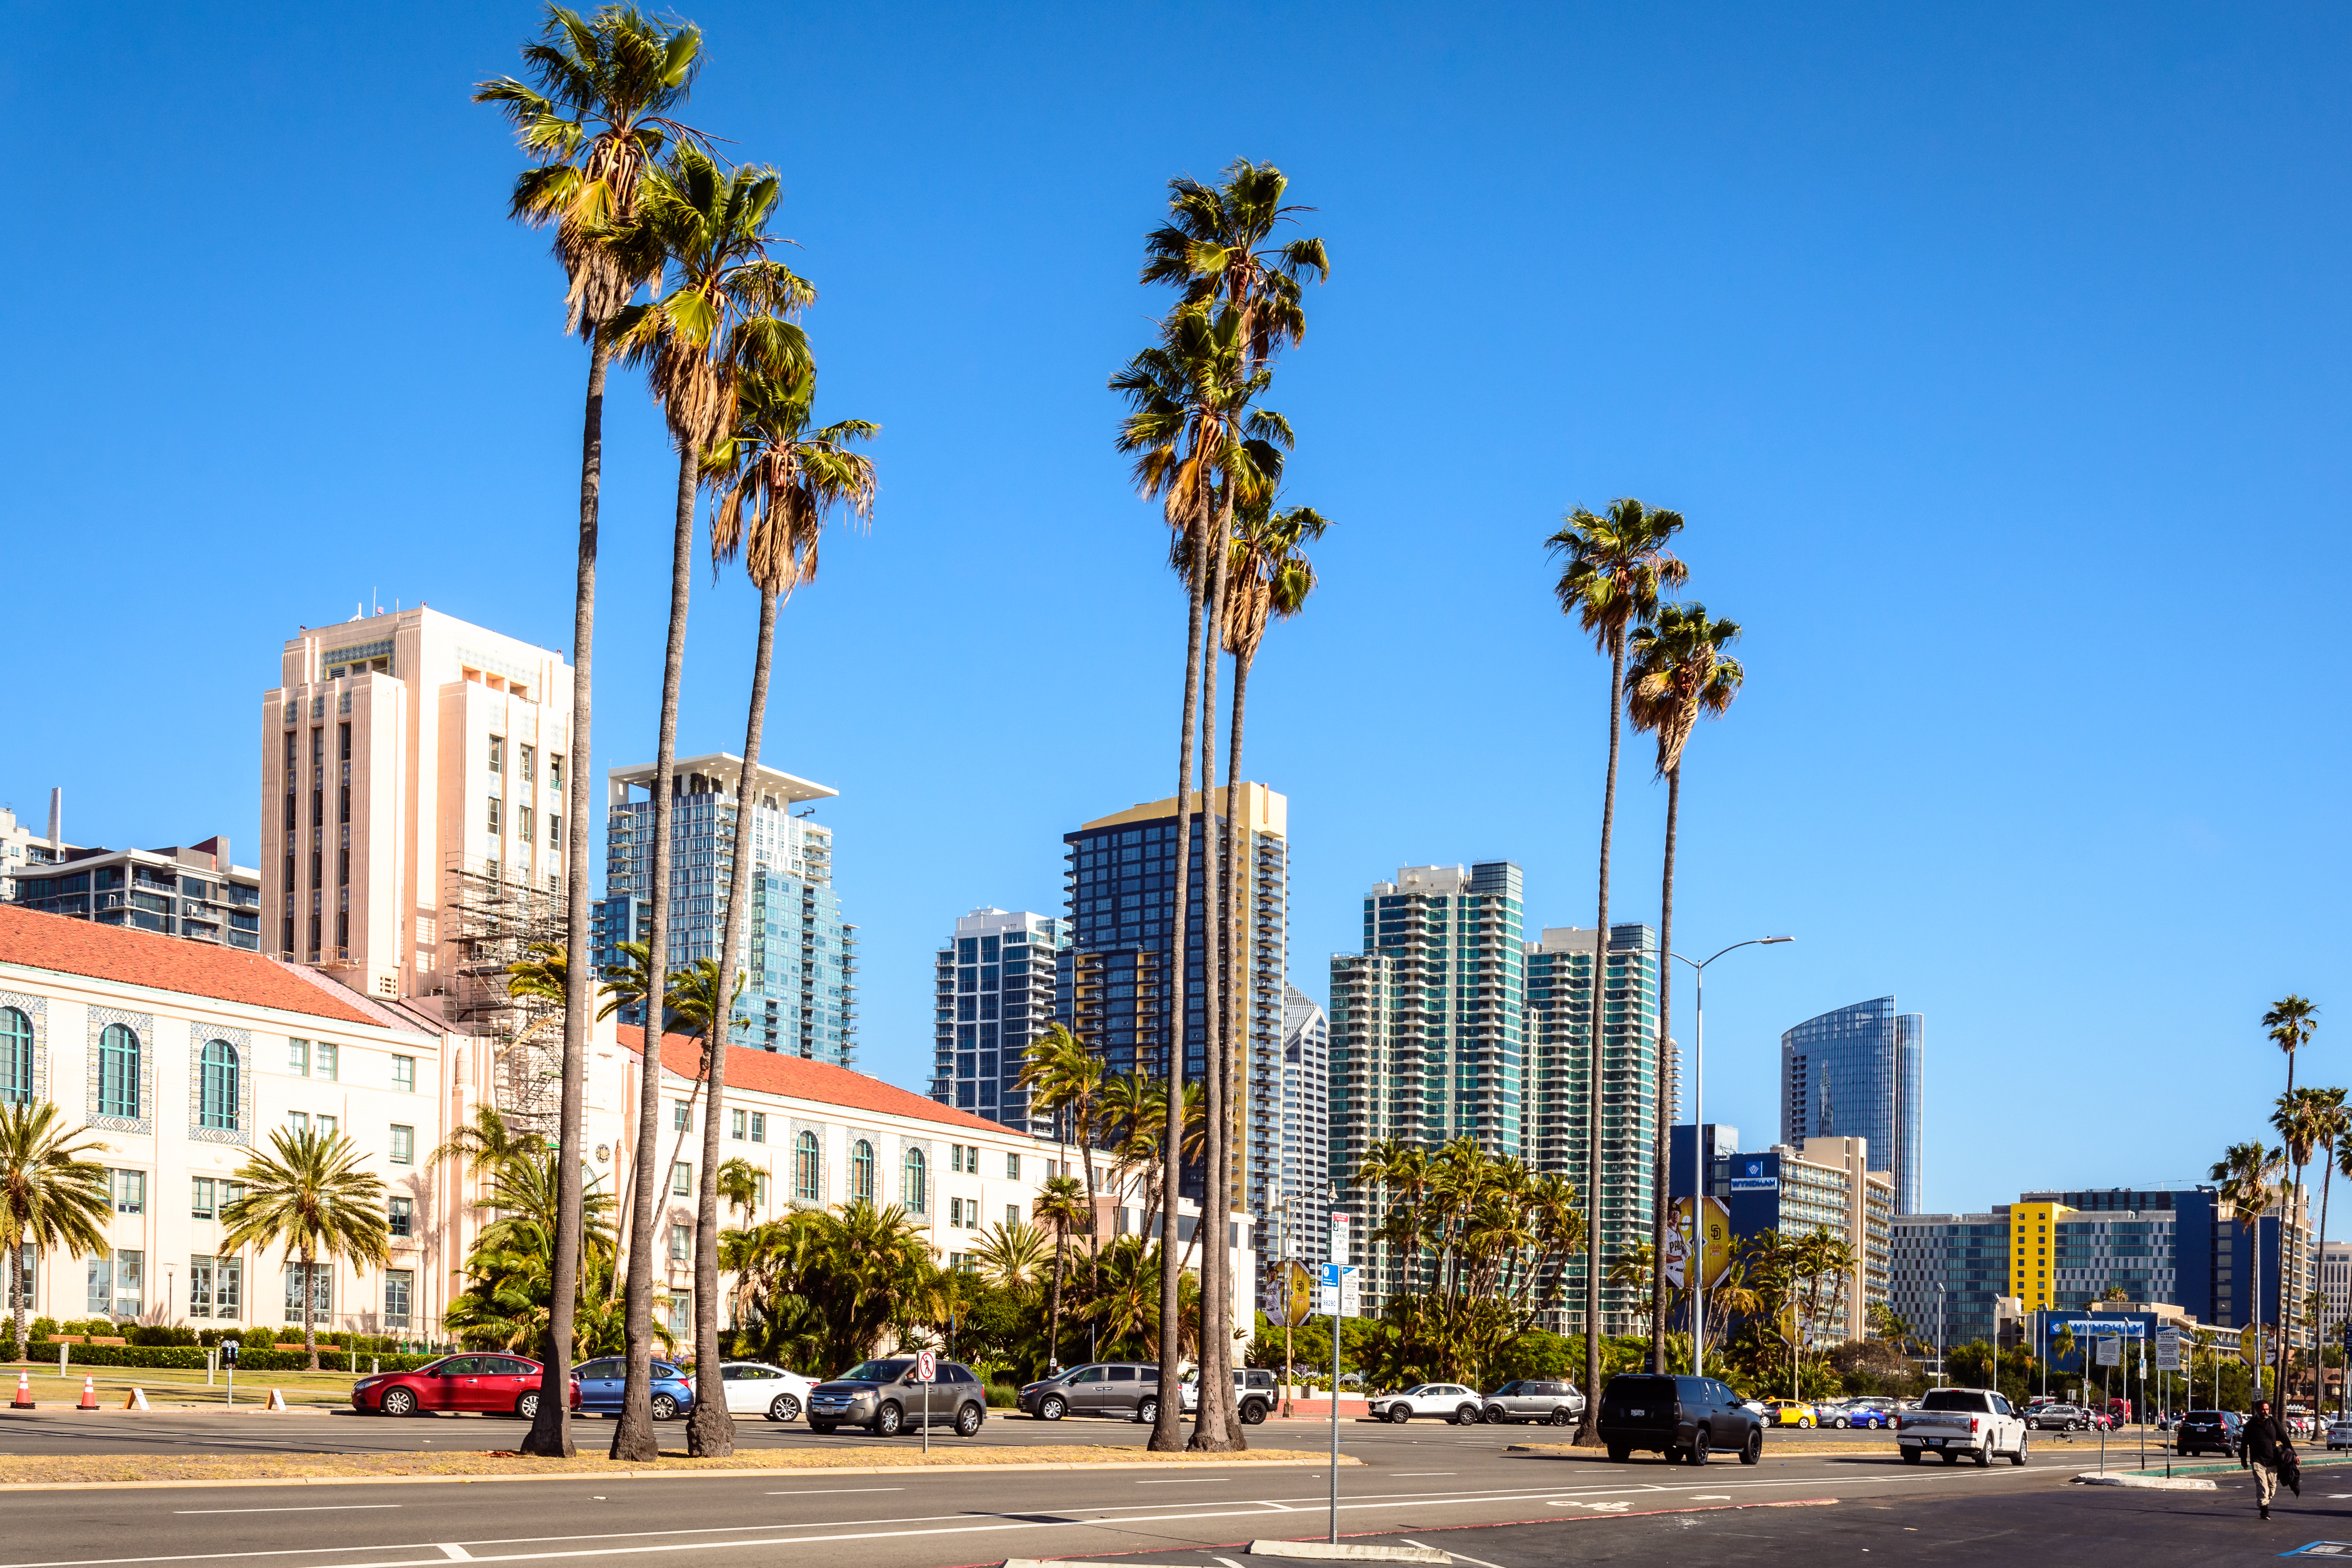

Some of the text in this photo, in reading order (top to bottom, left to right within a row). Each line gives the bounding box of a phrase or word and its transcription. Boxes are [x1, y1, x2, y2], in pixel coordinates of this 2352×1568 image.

[1732, 1179, 1777, 1188] WYNDHAM
[1334, 1221, 1338, 1231] 3
[1711, 1224, 1721, 1240] SD
[1669, 1240, 1683, 1253] PAD
[1297, 1281, 1304, 1292] SD
[2070, 1323, 2143, 1334] WYNDHAM
